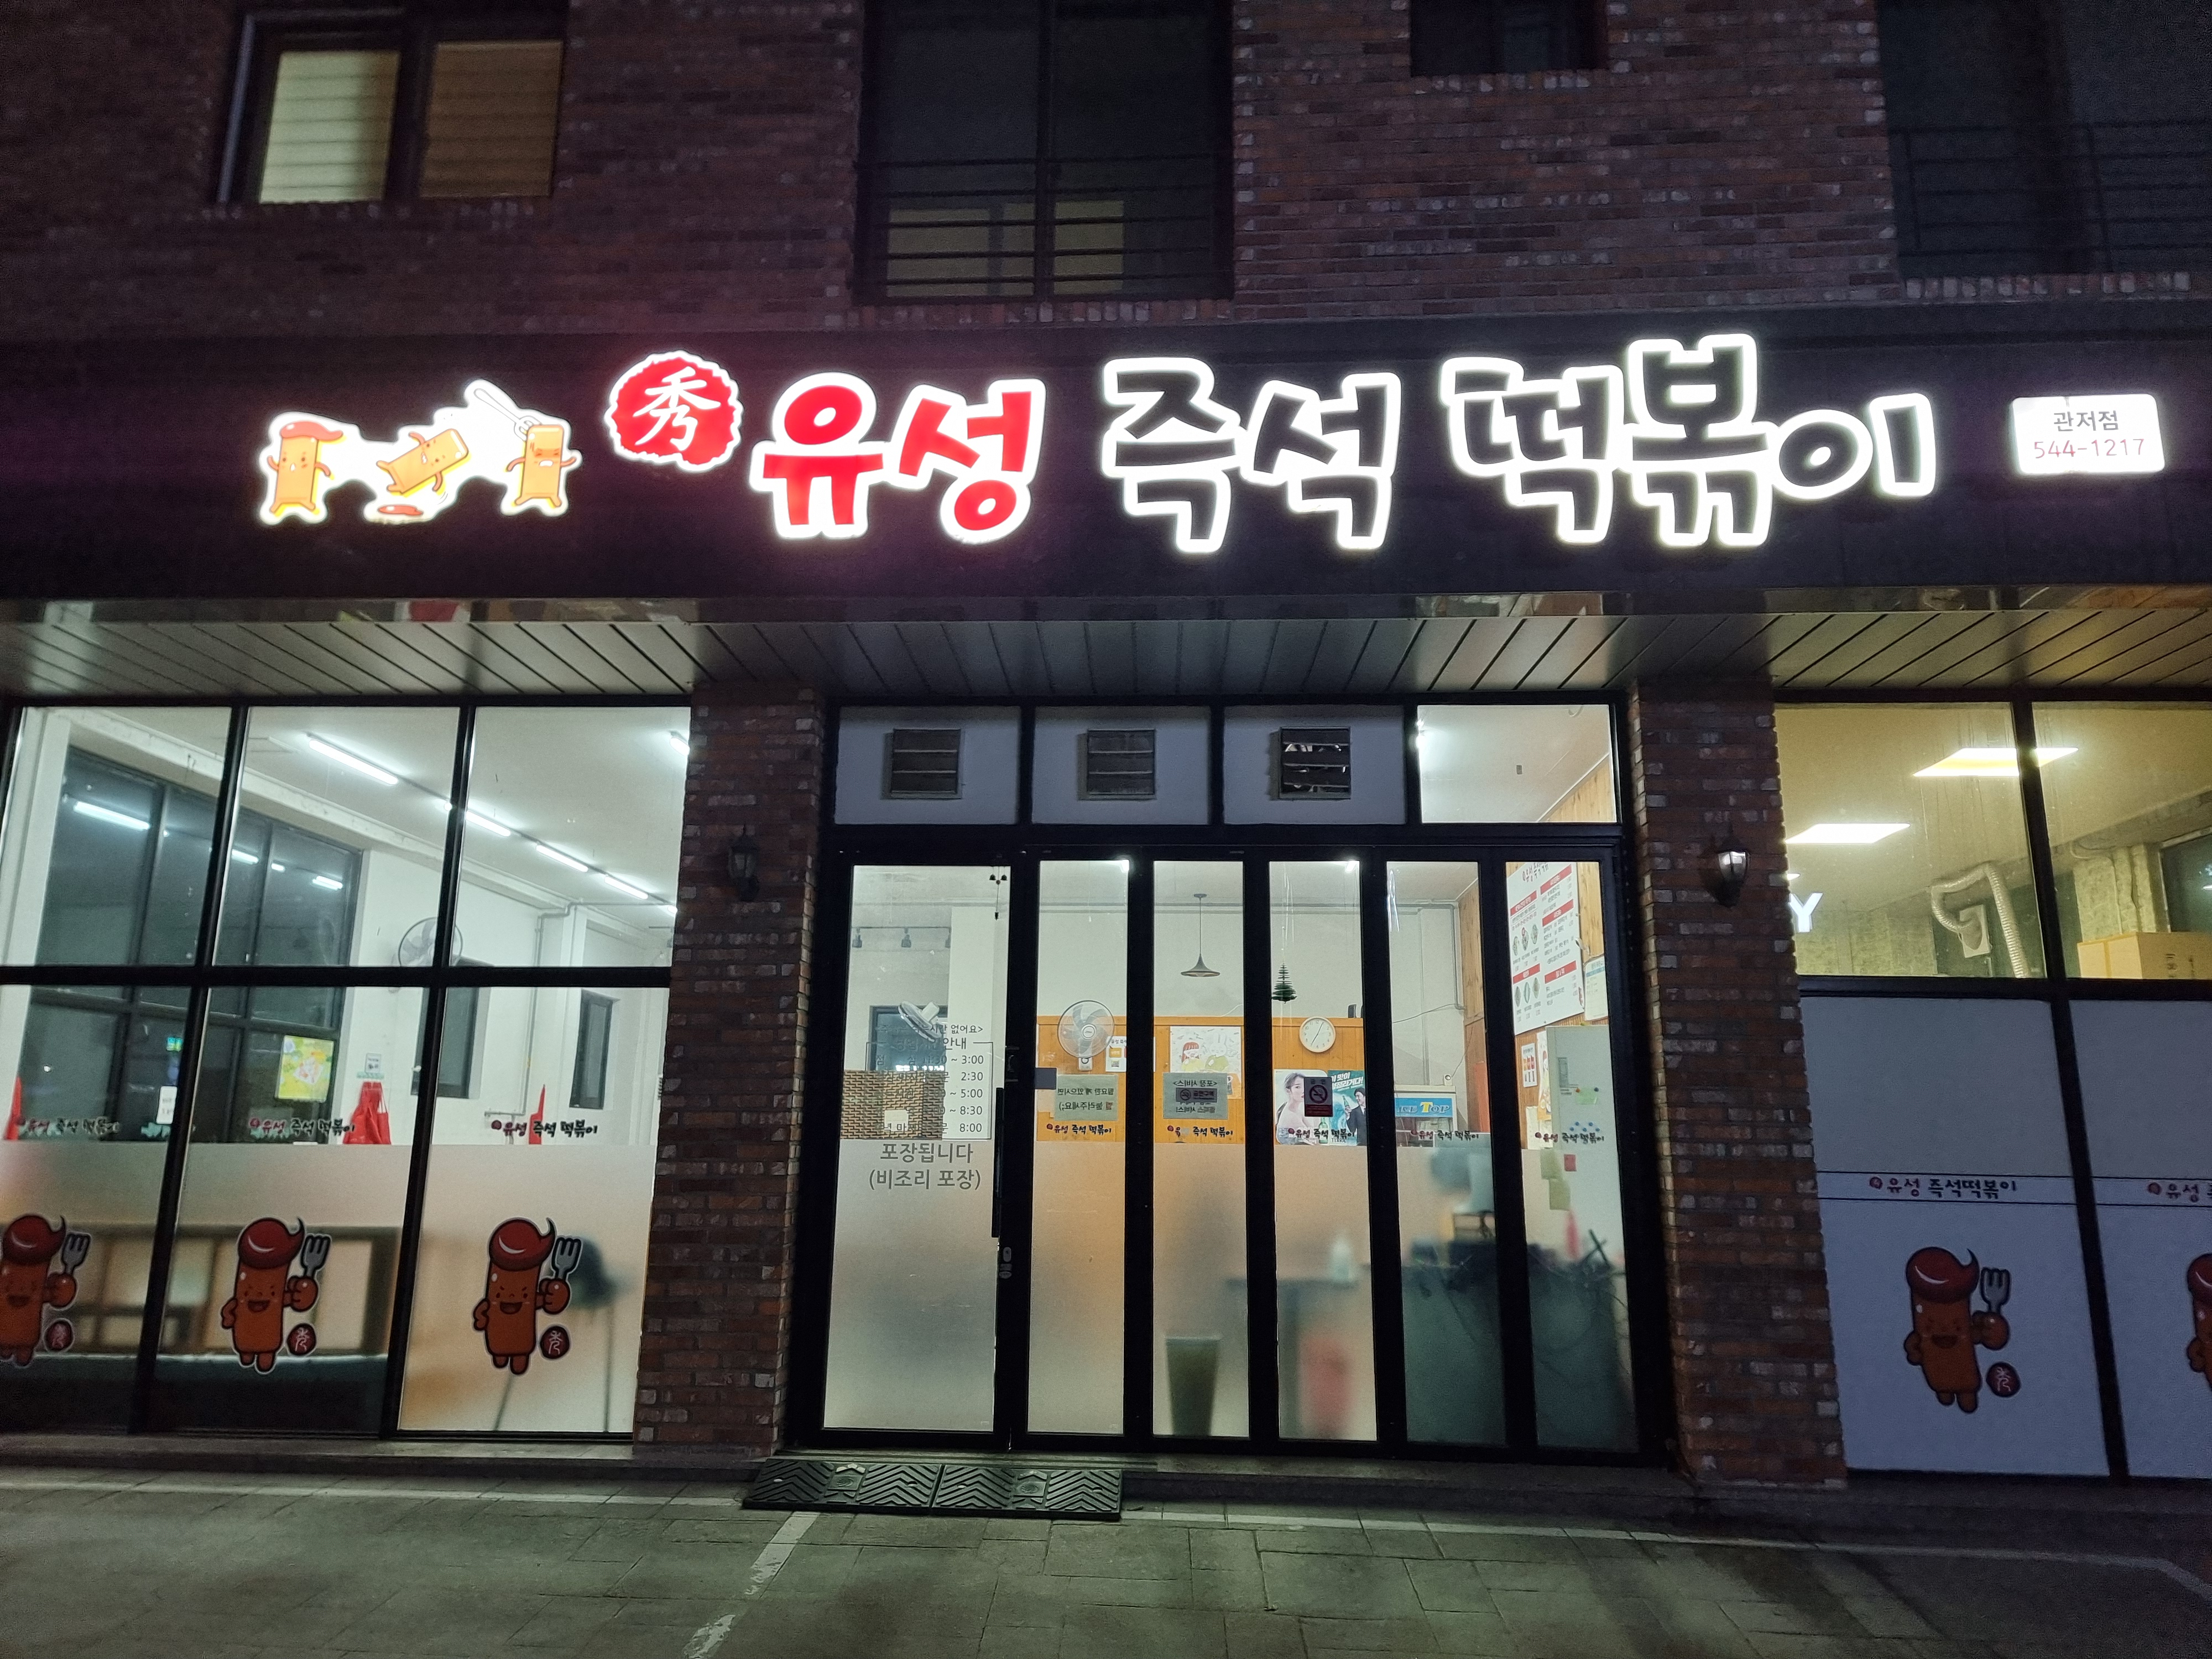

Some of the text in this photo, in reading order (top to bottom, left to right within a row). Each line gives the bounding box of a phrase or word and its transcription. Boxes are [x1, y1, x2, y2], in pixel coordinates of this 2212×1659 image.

[633, 365, 701, 449] 秀
[2053, 410, 2119, 432] 관저점
[760, 337, 1932, 546] 유성 즉석 떡볶이
[2034, 438, 2145, 459] 544-1217
[951, 1024, 984, 1034] 없어요>
[943, 1037, 967, 1050] 안내
[961, 1055, 984, 1065] 3:00
[961, 1072, 984, 1081] 2:30
[960, 1089, 983, 1098] 5:00
[959, 1106, 983, 1115] 8:30
[291, 1118, 316, 1136] 즉석
[503, 1121, 527, 1137] 유성
[533, 1120, 556, 1138] 즉석
[560, 1119, 598, 1138] 떡볶이
[959, 1123, 982, 1133] 8:00
[1054, 1124, 1069, 1134] 유성
[1072, 1124, 1087, 1135] 즉석
[1193, 1126, 1208, 1137] 즉석
[1295, 1129, 1311, 1139] 유성
[1313, 1128, 1328, 1139] 즉석
[880, 1142, 974, 1164] 포장됩니다
[869, 1168, 981, 1191] (비조리 포장)
[1886, 1177, 1920, 1197] 유성
[2166, 1183, 2199, 1203] 유성
